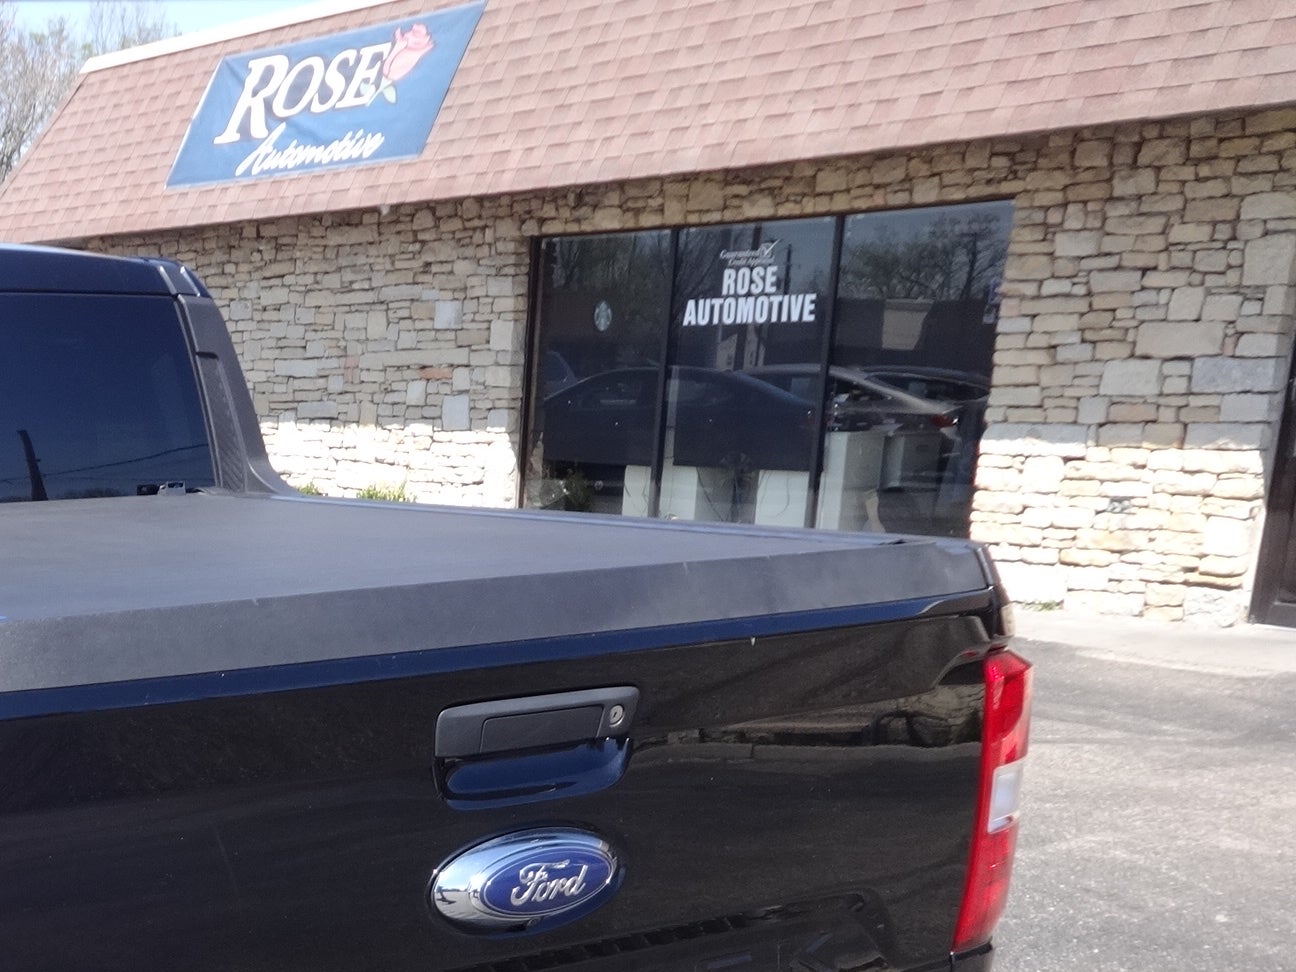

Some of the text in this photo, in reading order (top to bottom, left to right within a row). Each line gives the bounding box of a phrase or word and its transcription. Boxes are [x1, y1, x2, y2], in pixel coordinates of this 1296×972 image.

[213, 41, 392, 145] ROSE
[235, 122, 385, 177] Automotive
[721, 265, 779, 296] ROSE
[682, 293, 817, 327] AUTOMOTIVE
[510, 858, 589, 906] Ford
